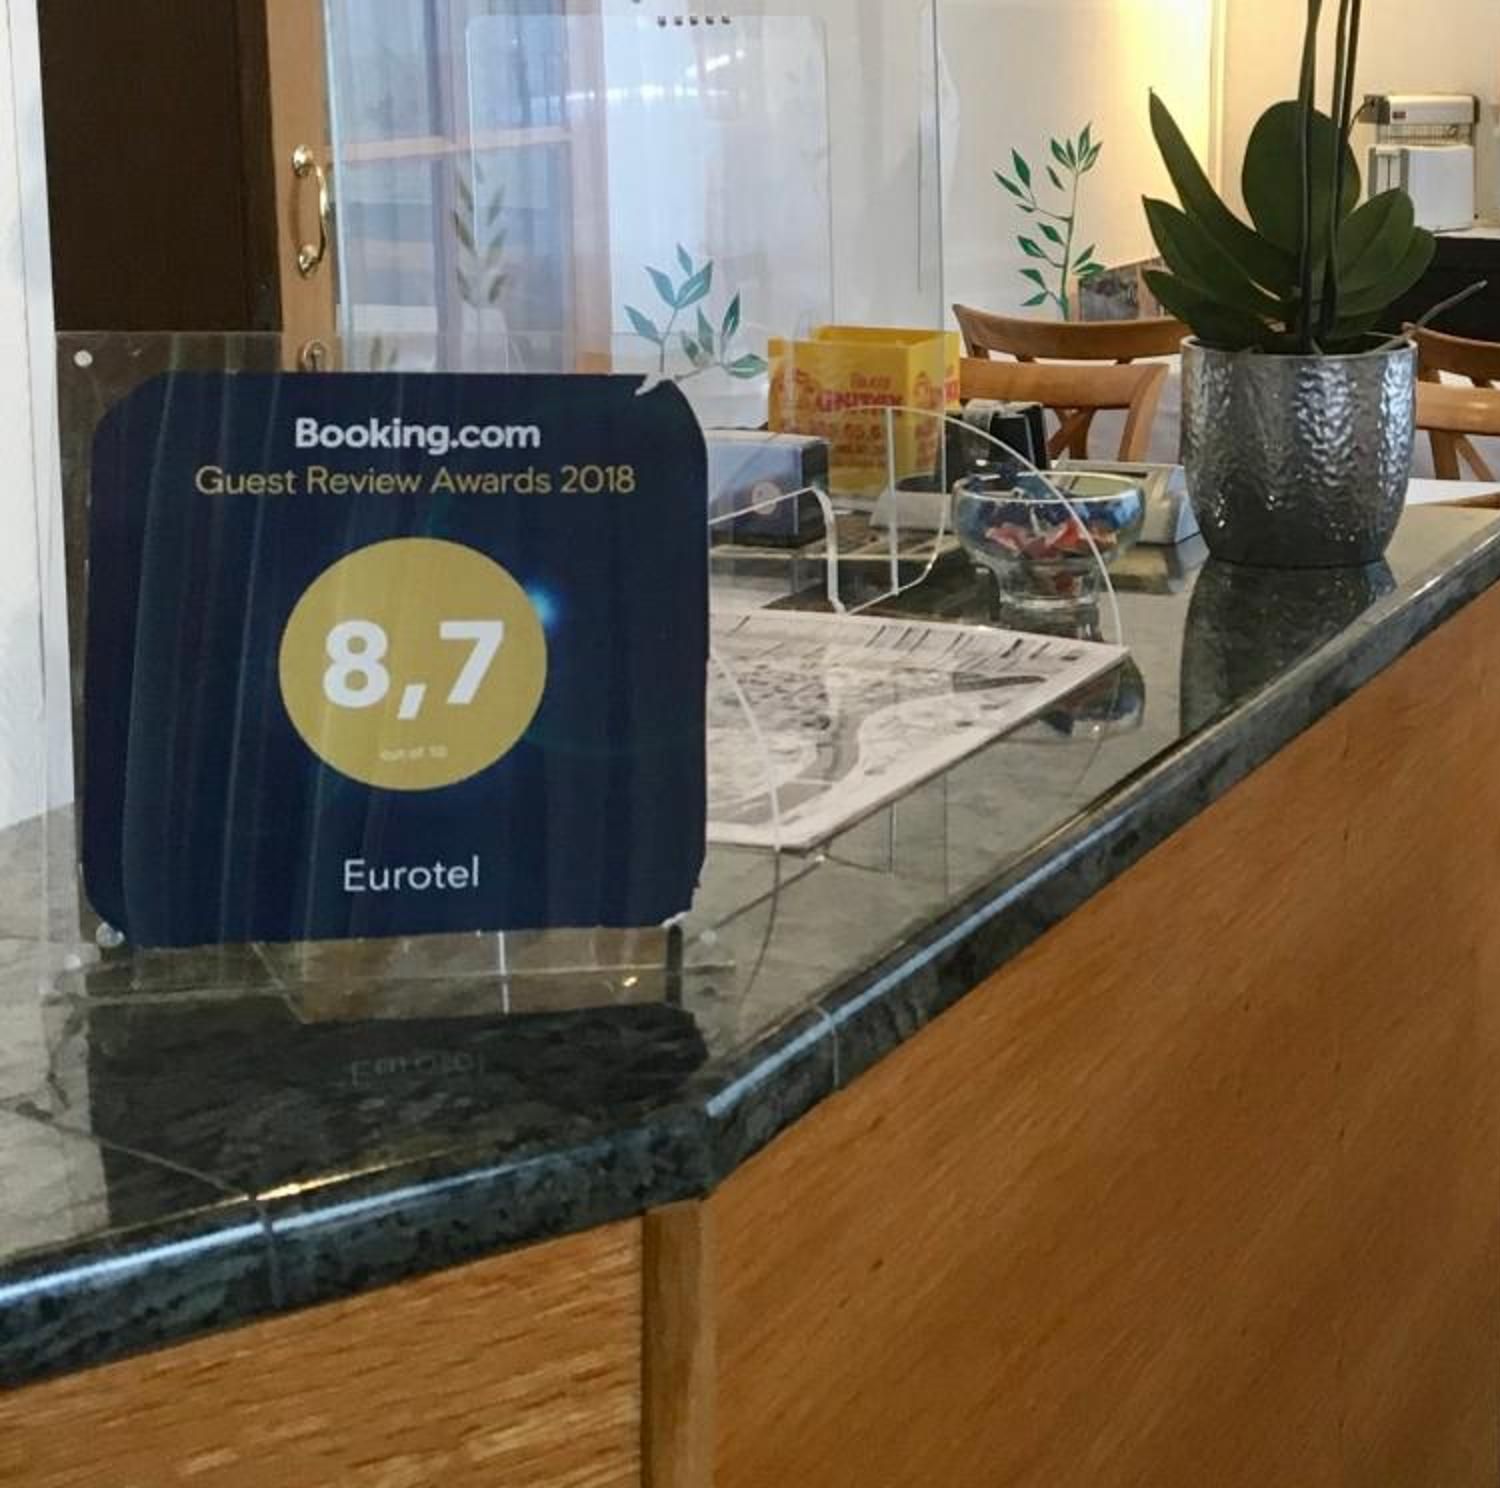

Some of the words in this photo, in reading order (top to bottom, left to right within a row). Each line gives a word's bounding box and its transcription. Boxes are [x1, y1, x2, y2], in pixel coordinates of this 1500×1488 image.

[294, 417, 541, 455] Booking.com
[194, 465, 297, 495] Guest
[306, 465, 422, 495] Review
[430, 465, 552, 495] Awards
[560, 465, 637, 495] 2018
[322, 619, 505, 721] 8,7
[343, 854, 480, 892] Eurotel
